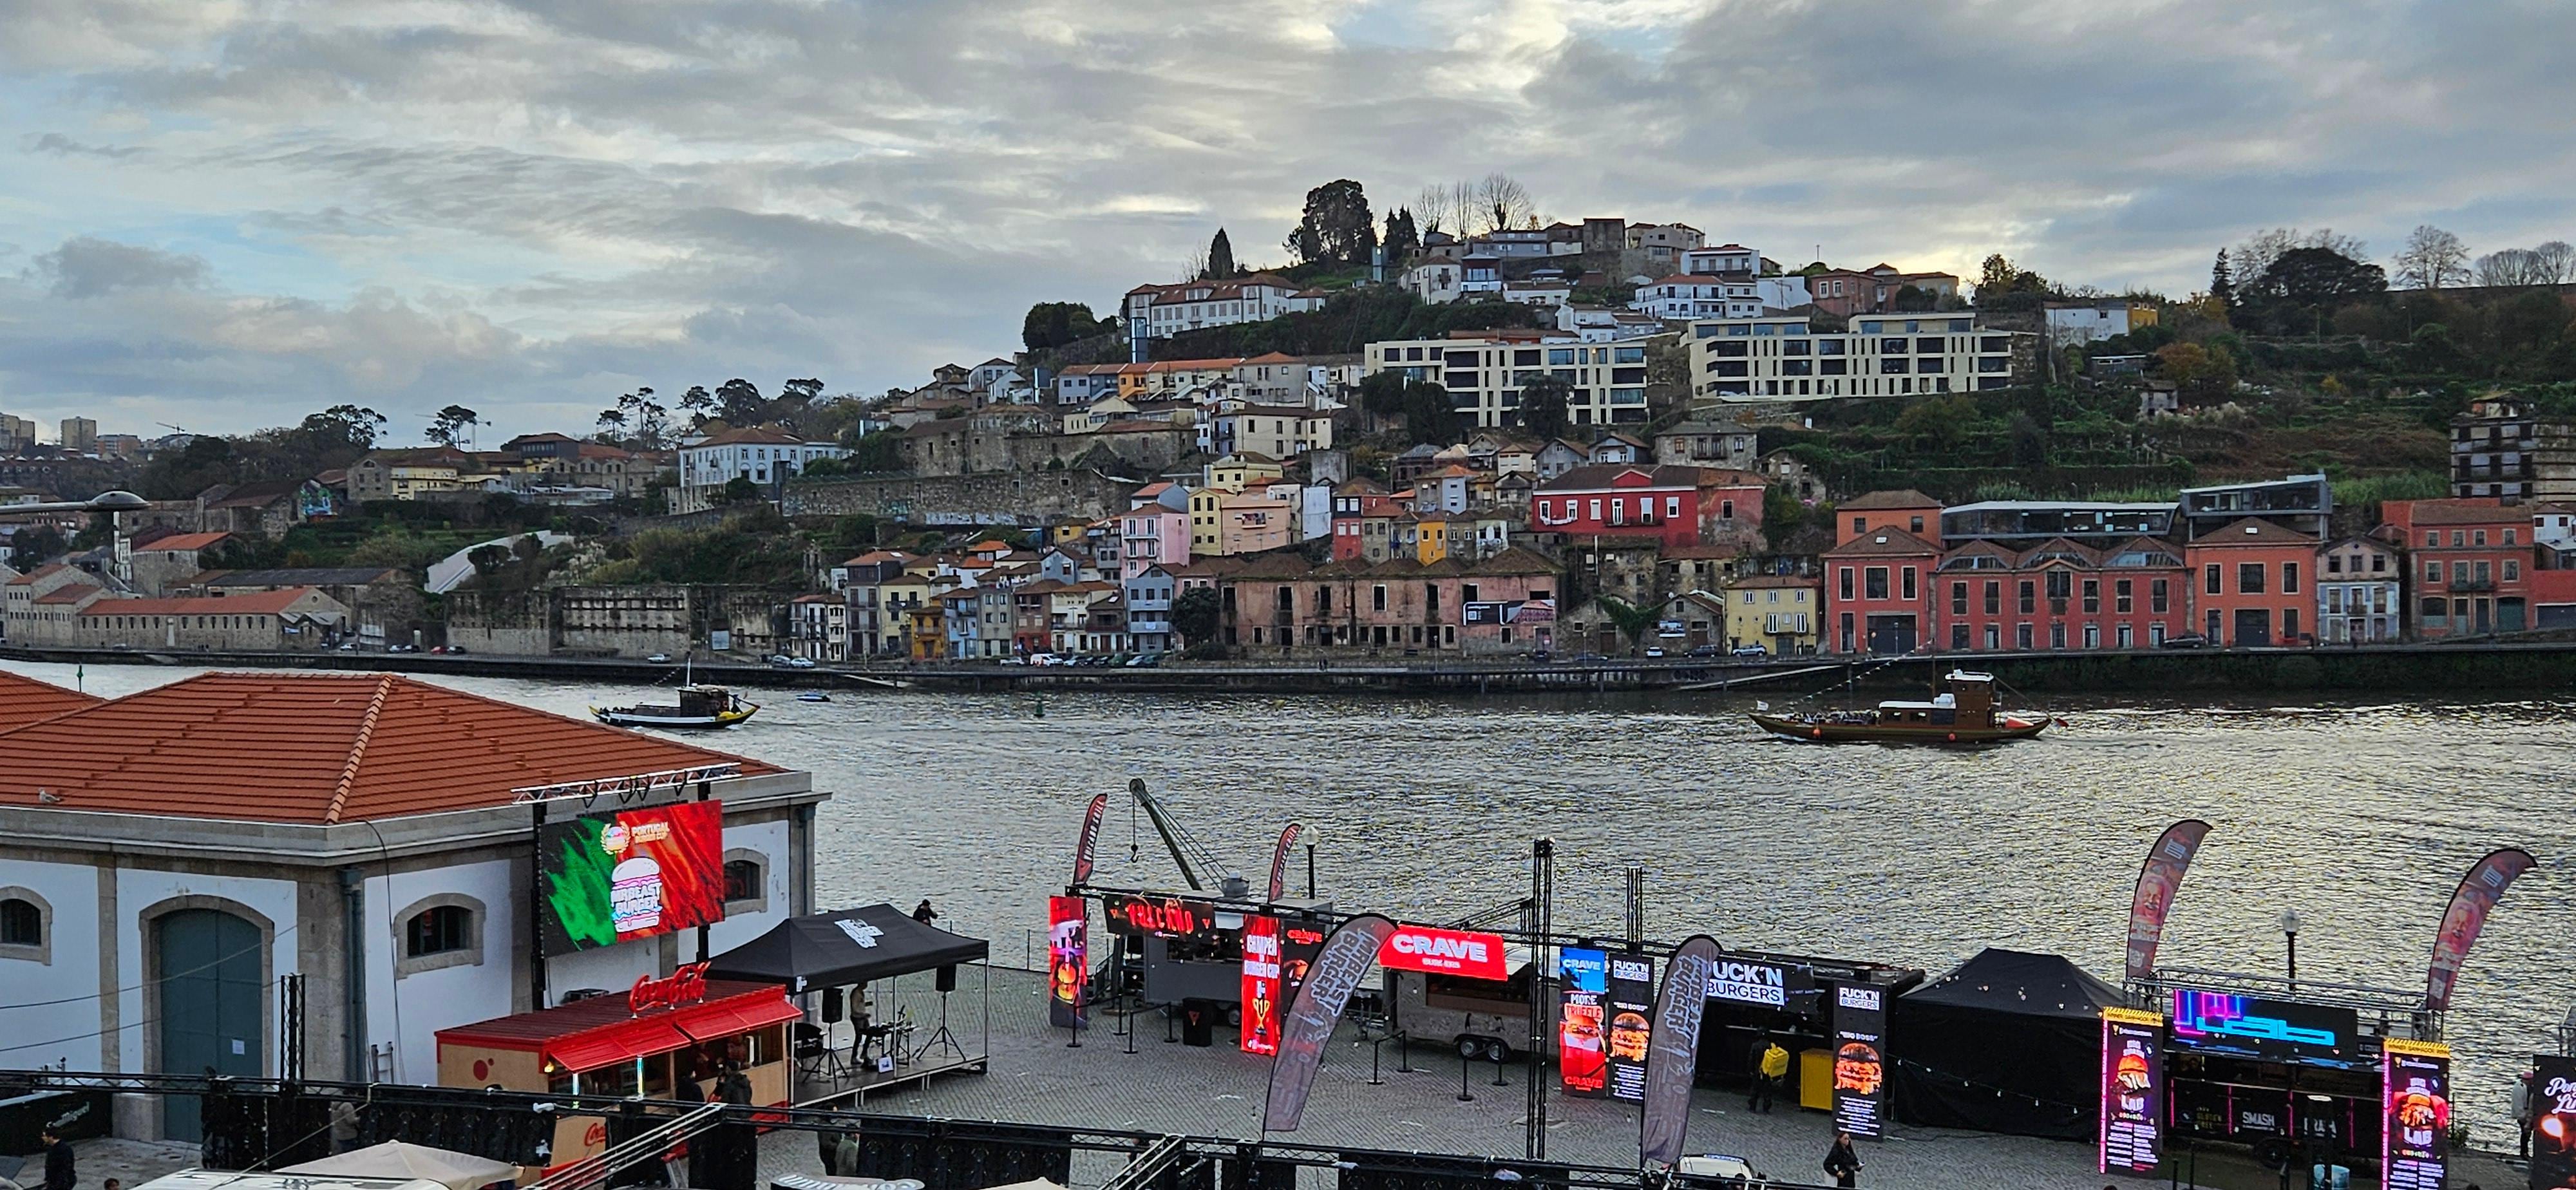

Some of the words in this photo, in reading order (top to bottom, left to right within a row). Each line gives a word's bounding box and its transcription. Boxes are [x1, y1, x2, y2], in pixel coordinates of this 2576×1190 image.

[1287, 929, 1323, 943] CRAVE
[1392, 934, 1488, 963] CRAVE
[1311, 930, 1360, 999] BURGER
[1318, 930, 1381, 1017] MRBEAST
[1562, 959, 1601, 970] CRAVE
[1713, 961, 1783, 987] UCK'N
[1571, 994, 1597, 1005] MORE
[1663, 955, 1695, 1030] BURGER
[1708, 981, 1781, 1003] BURGERS
[2242, 1111, 2275, 1126] SMASH
[2404, 1126, 2432, 1147] LAB
